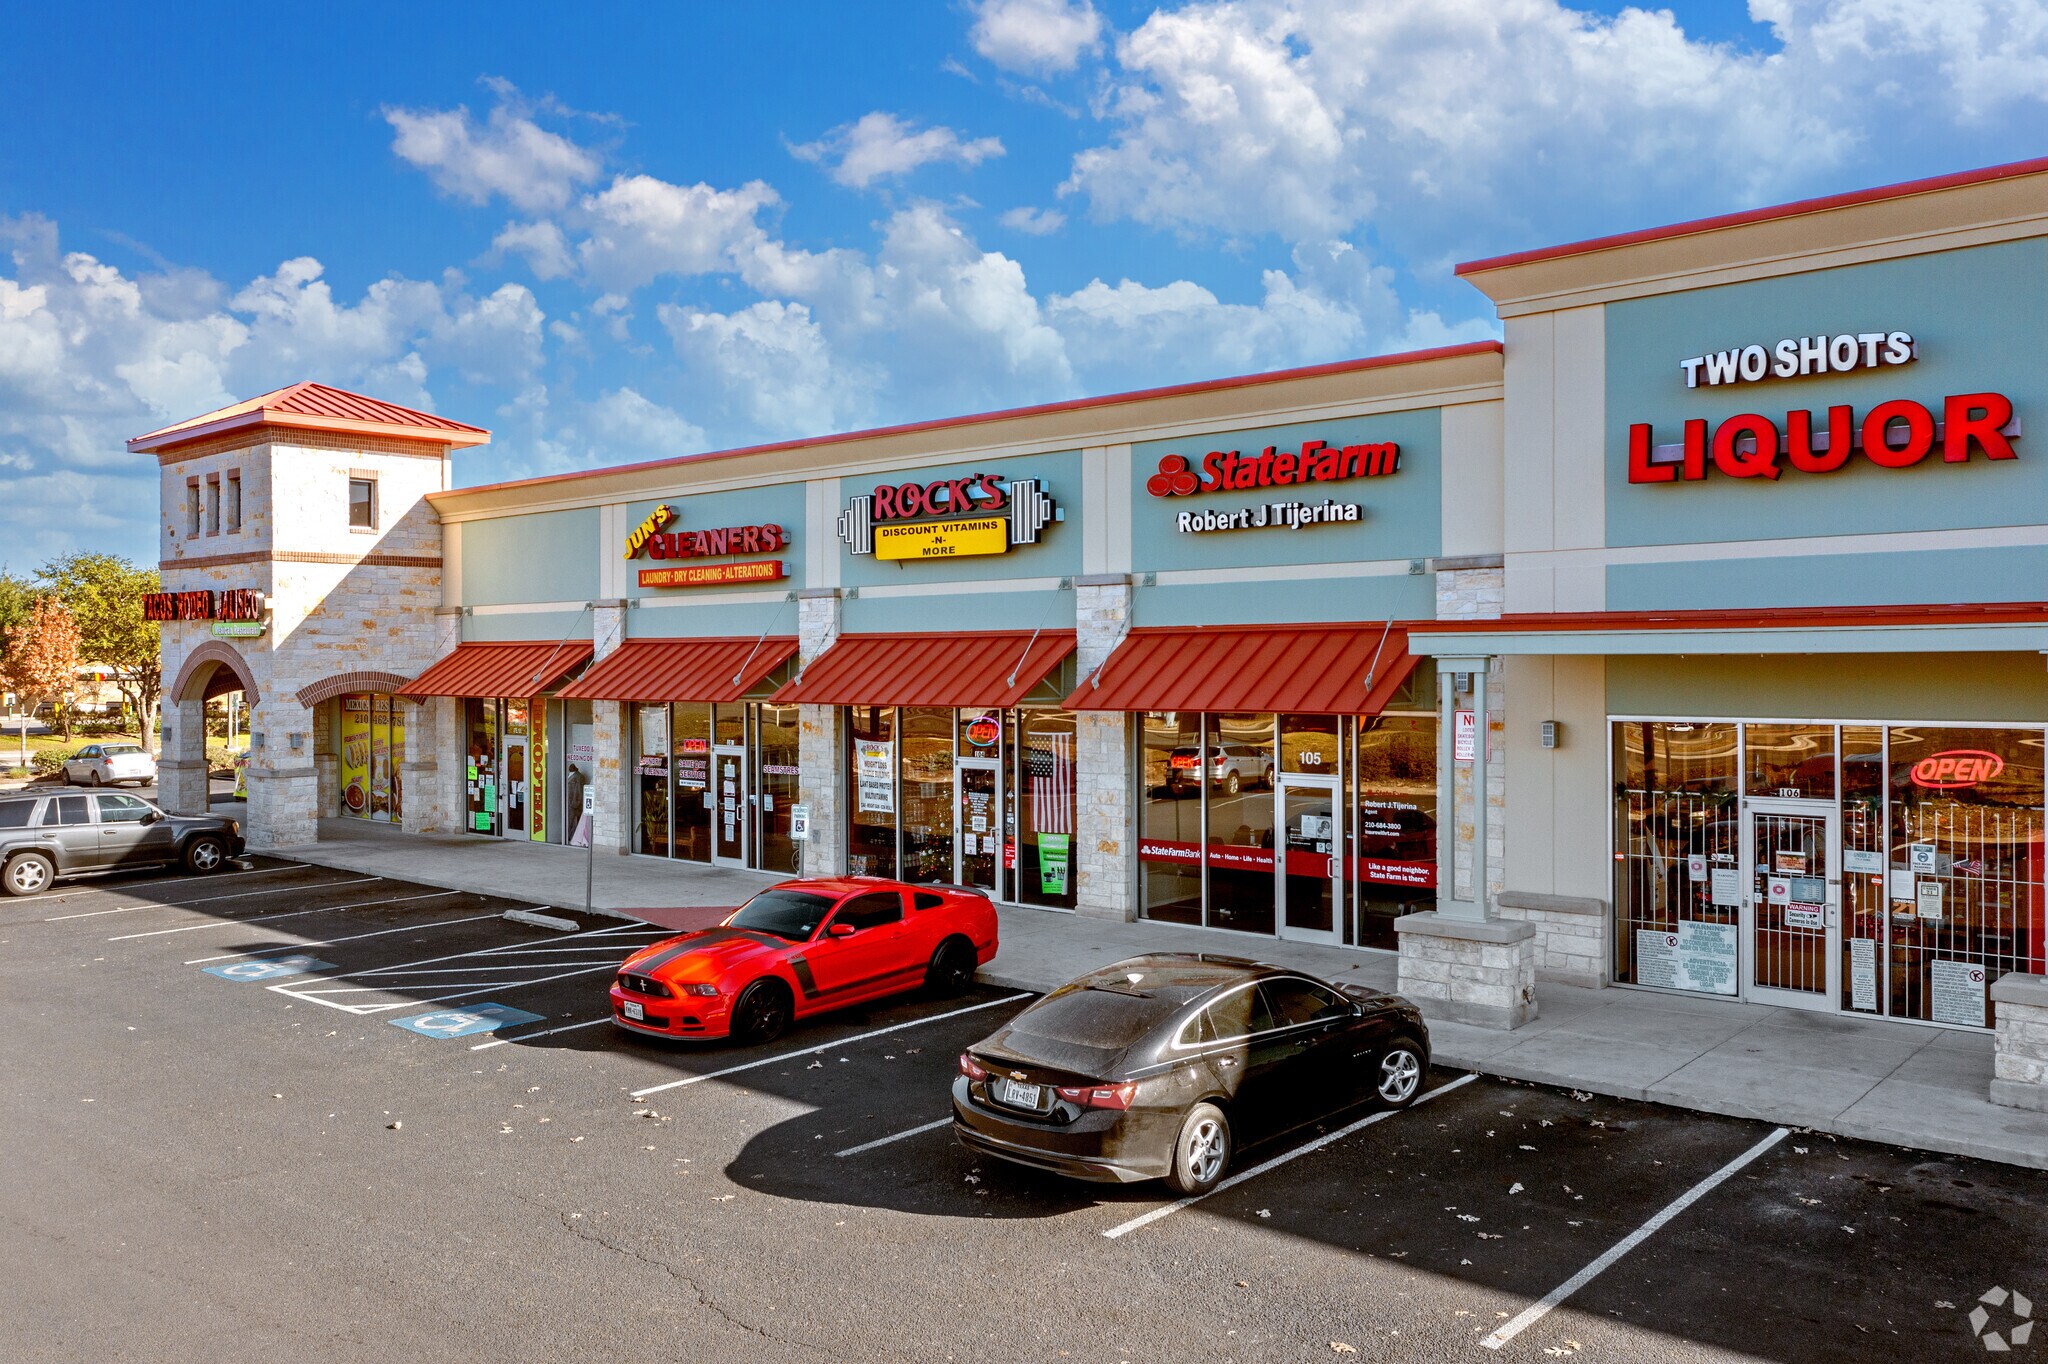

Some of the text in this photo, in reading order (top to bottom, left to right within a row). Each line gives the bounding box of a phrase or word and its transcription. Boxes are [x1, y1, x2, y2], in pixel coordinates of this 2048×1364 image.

[1680, 331, 1914, 389] TWO SHOTS
[1628, 392, 2018, 484] LIQUOR
[874, 473, 1004, 520] ROCK'S
[1177, 499, 1360, 532] Robert J Tijerina
[623, 504, 672, 560] JUN'S
[882, 521, 998, 537] DISCOUNT VITAMINS
[649, 523, 781, 560] CLEANERS
[922, 546, 956, 556] MORE
[674, 570, 687, 582] DRY
[688, 568, 722, 581] CLEANING
[725, 563, 773, 579] ALTERATIONS
[142, 588, 260, 620] TACOS RODEO JALISCO
[345, 699, 374, 711] MEXICA
[968, 724, 998, 739] OPEN
[685, 740, 704, 751] OPEN
[679, 759, 706, 768] SAME DAY
[1171, 756, 1194, 768] OPEN
[1299, 752, 1321, 765] 105
[533, 704, 544, 834] WELCOME
[680, 770, 705, 779] SERVICE
[1917, 757, 1993, 782] OPEN
[1781, 788, 1799, 797] 106
[1365, 800, 1386, 808] Robert
[1393, 802, 1417, 810] Tijerina
[1256, 856, 1273, 864] Health
[1386, 872, 1401, 880] Farm
[1789, 903, 1819, 913] WARNING
[1892, 903, 1916, 914] 21
